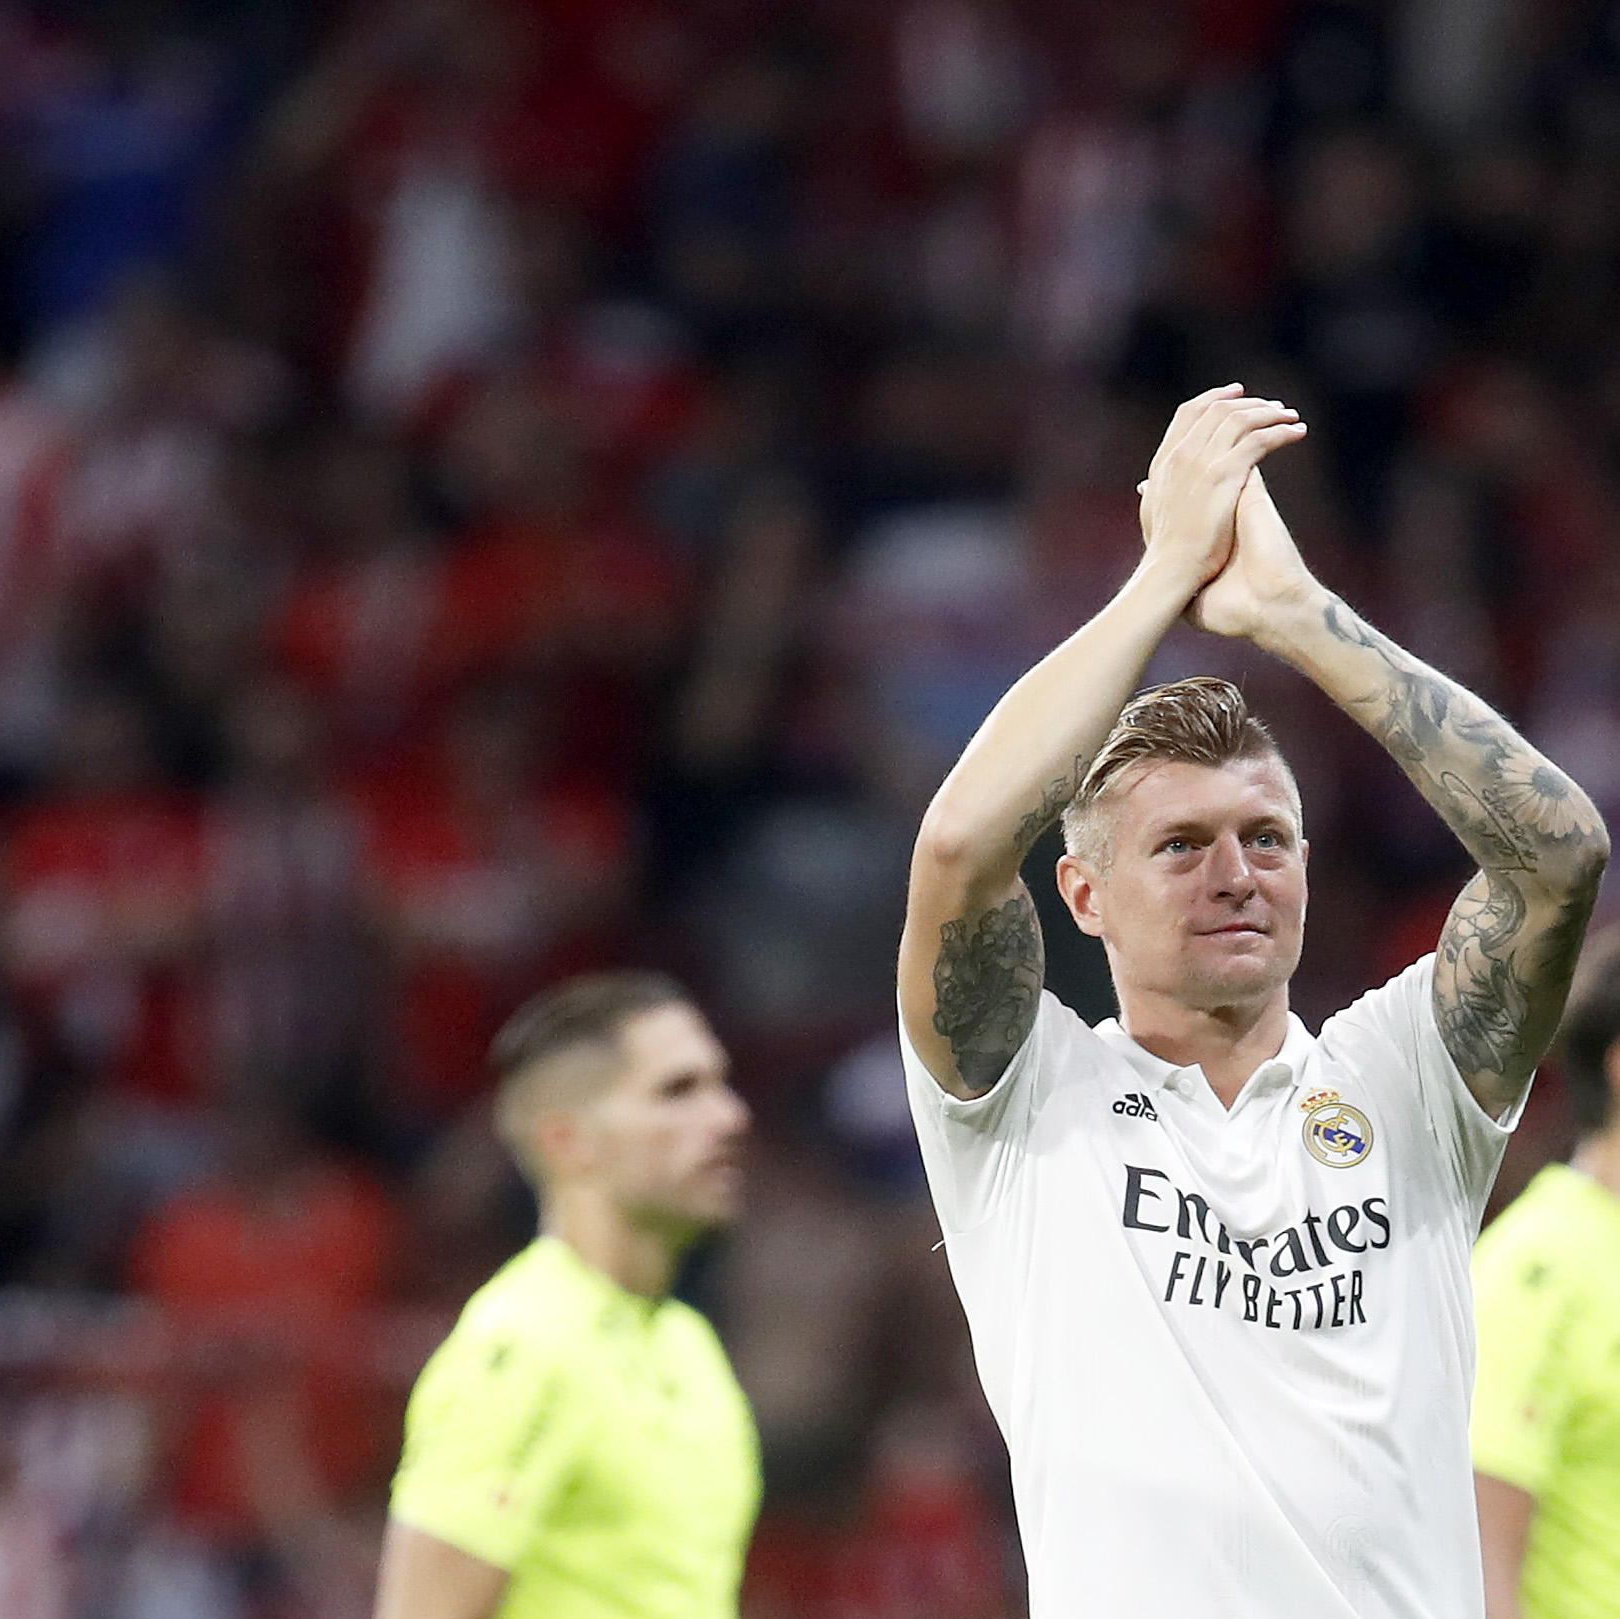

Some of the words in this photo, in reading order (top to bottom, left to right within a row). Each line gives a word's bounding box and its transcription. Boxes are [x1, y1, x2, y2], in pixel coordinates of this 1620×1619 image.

[1123, 1164, 1391, 1277] Emrates
[1164, 1251, 1231, 1309] FLY
[1242, 1270, 1367, 1330] BETTER
